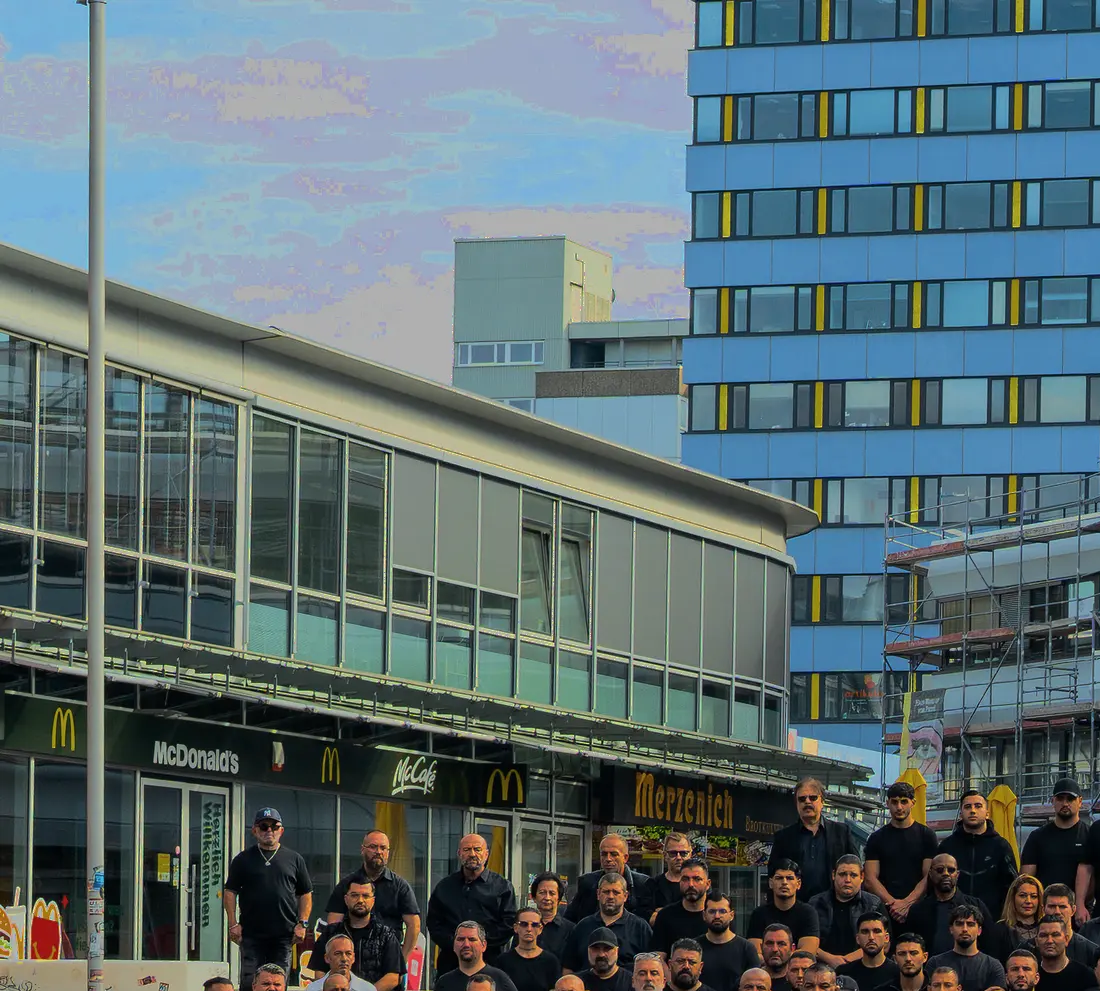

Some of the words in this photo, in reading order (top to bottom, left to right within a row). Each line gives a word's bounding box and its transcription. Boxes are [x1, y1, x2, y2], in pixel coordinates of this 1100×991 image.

[153, 740, 240, 775] McDonald's
[392, 755, 438, 792] McCafé
[634, 771, 734, 829] Merzenich
